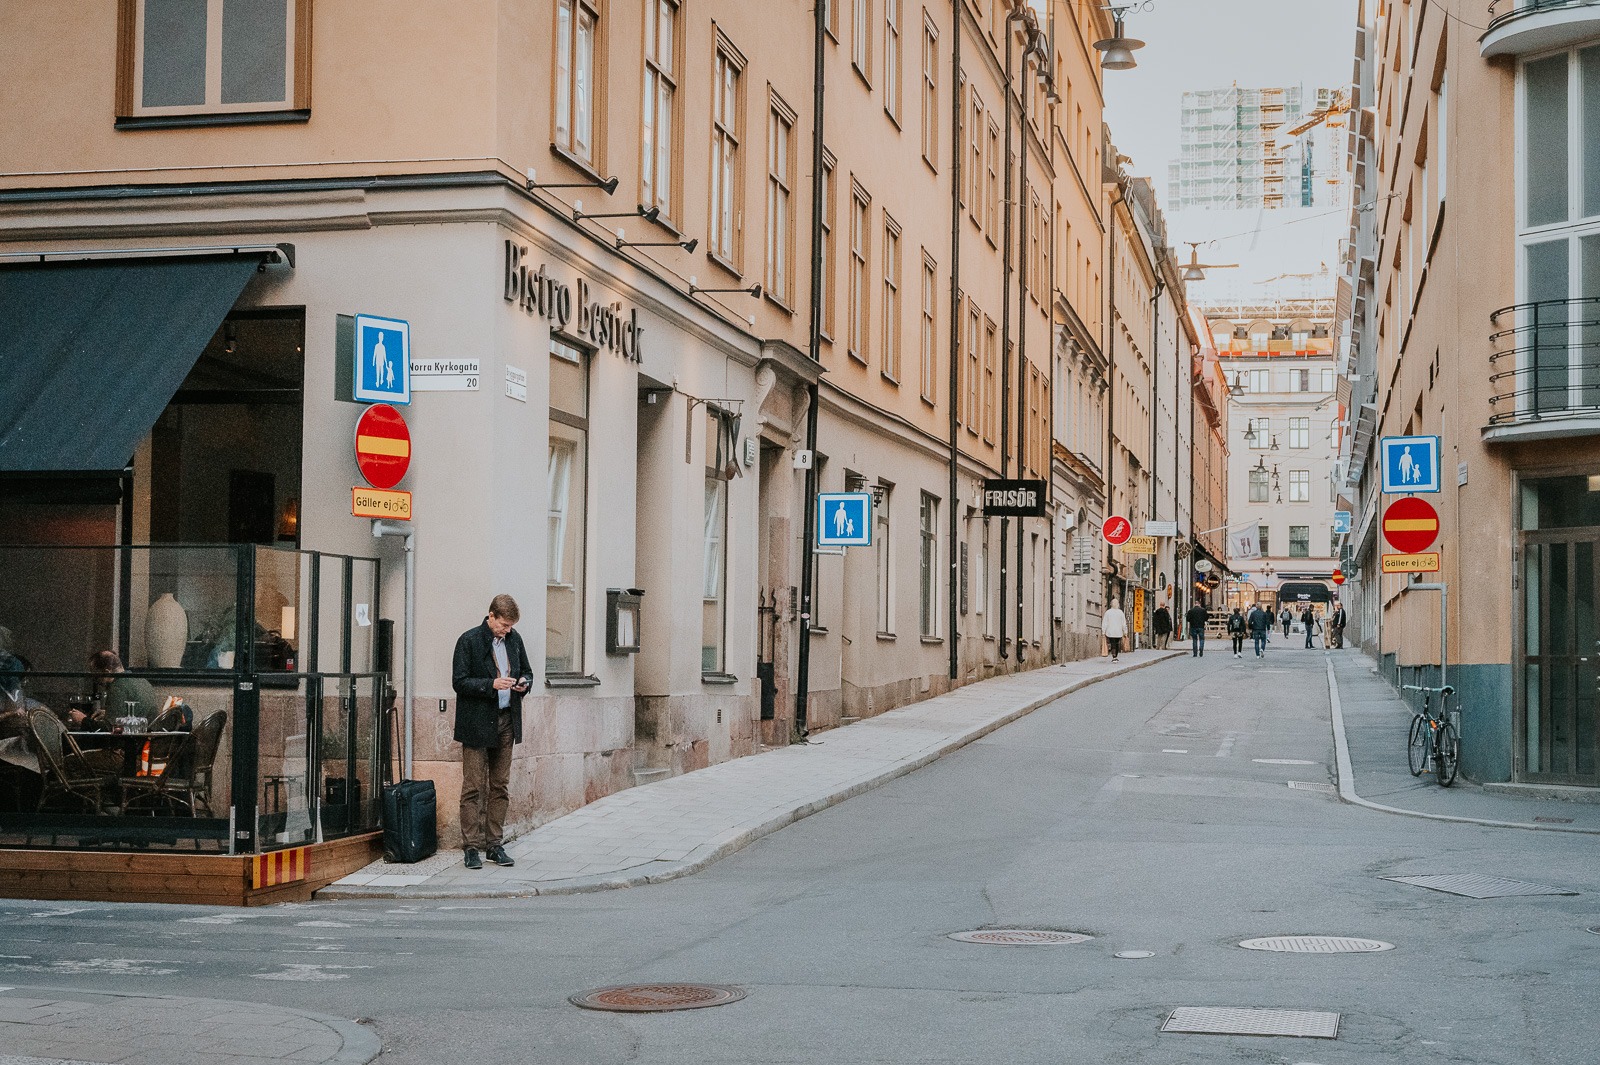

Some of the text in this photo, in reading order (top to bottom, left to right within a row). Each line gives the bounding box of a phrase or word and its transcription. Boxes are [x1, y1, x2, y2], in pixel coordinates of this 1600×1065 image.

[504, 239, 645, 364] Bistro Bestick
[409, 361, 478, 374] Norra Kyrkogata
[466, 377, 478, 388] 20
[801, 454, 808, 464] 8
[356, 496, 392, 511] Gäller ej
[985, 487, 1037, 508] FRISÖR
[1385, 559, 1419, 567] Gäller ej
